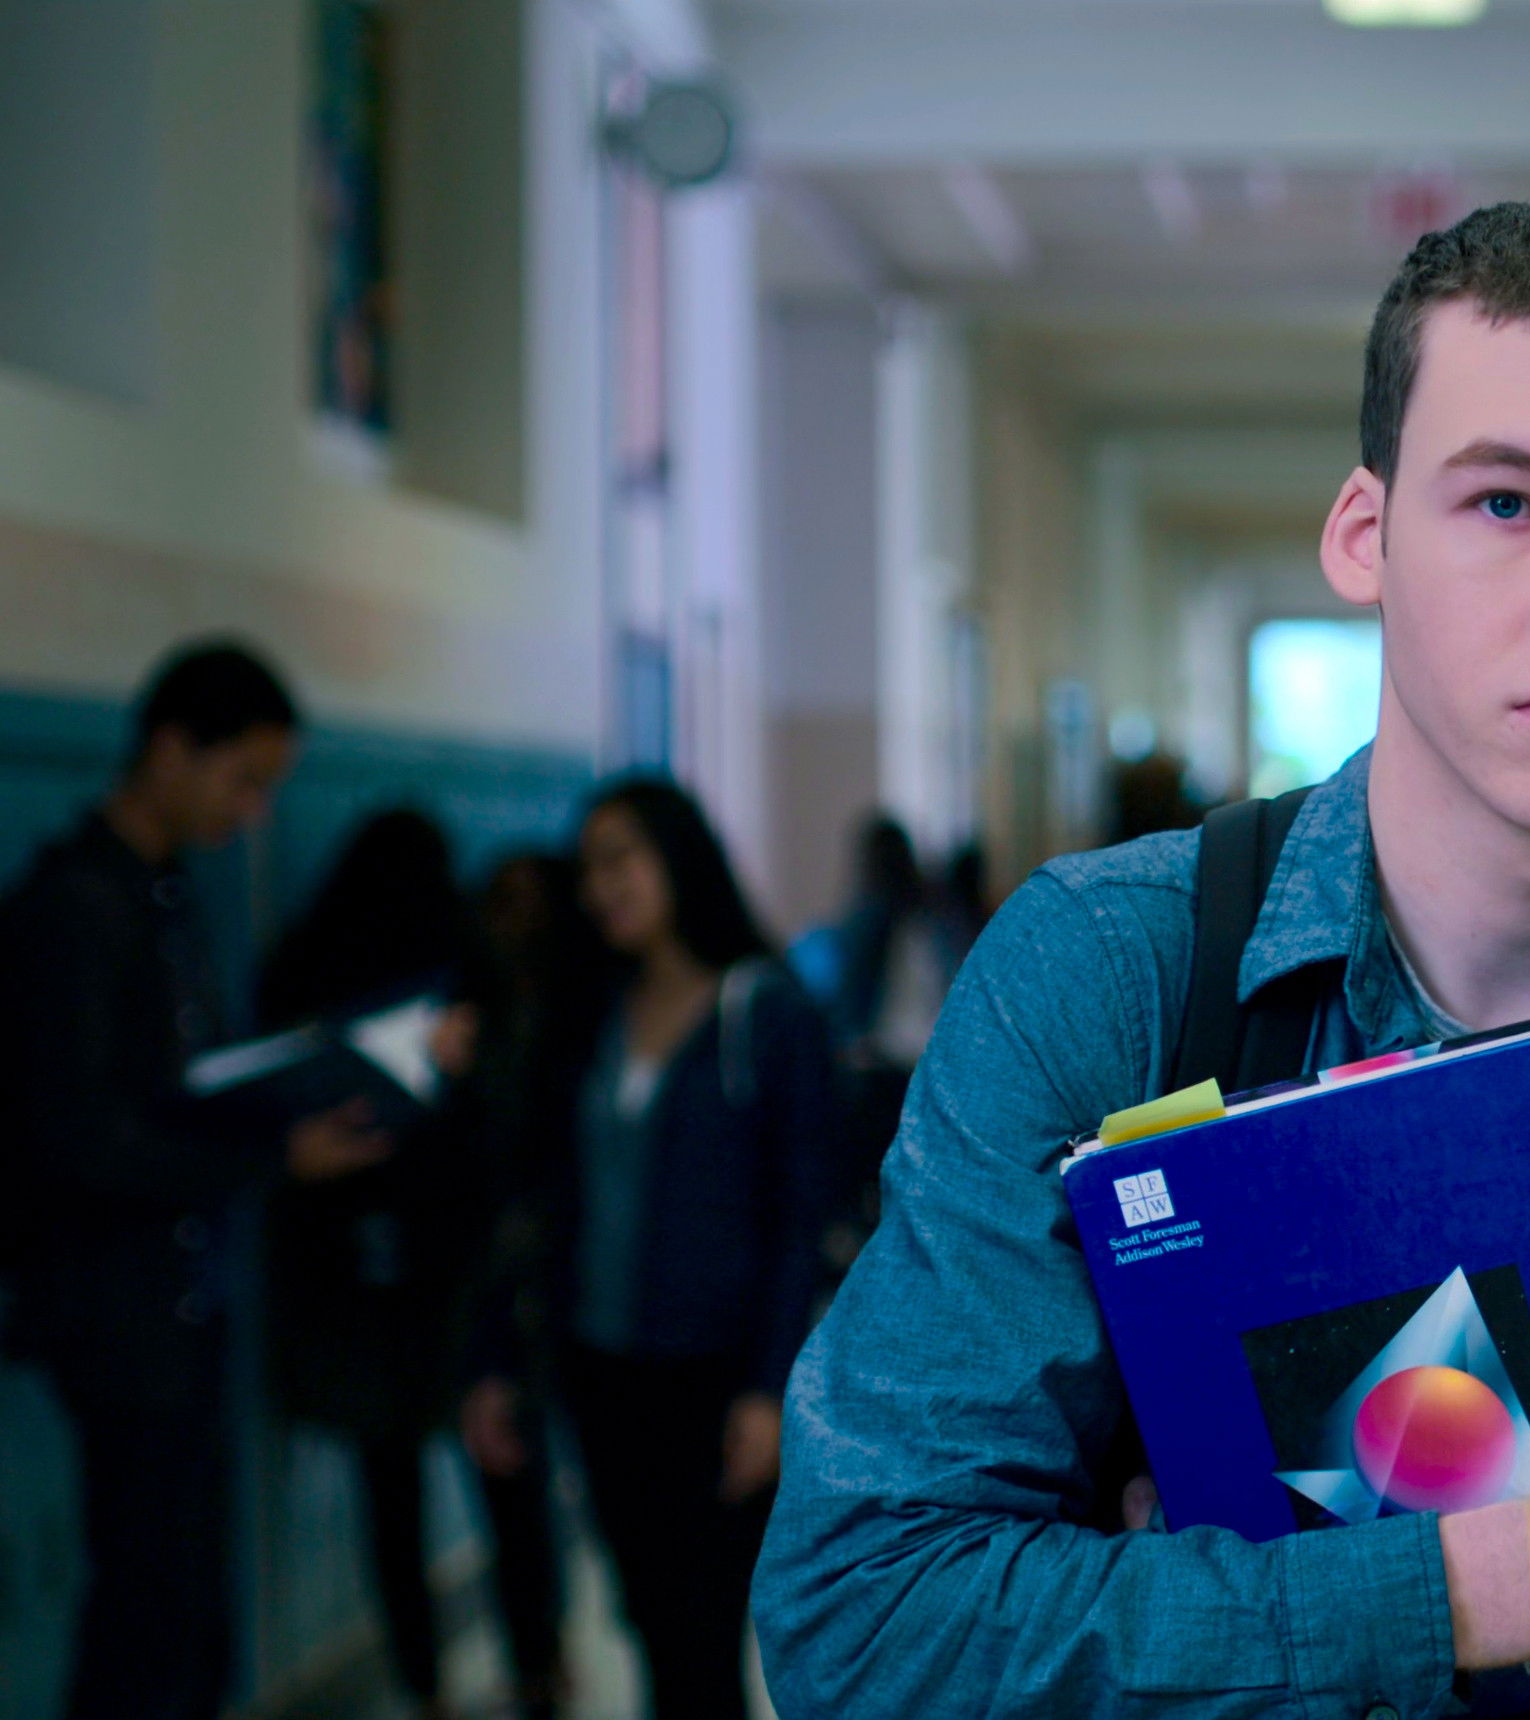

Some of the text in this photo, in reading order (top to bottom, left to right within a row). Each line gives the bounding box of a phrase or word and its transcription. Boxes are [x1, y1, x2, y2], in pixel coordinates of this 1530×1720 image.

[1122, 1175, 1158, 1198] S F
[1130, 1196, 1168, 1221] A W
[1109, 1220, 1201, 1251] Scott Foresman
[1115, 1234, 1205, 1266] Addison Wesley
